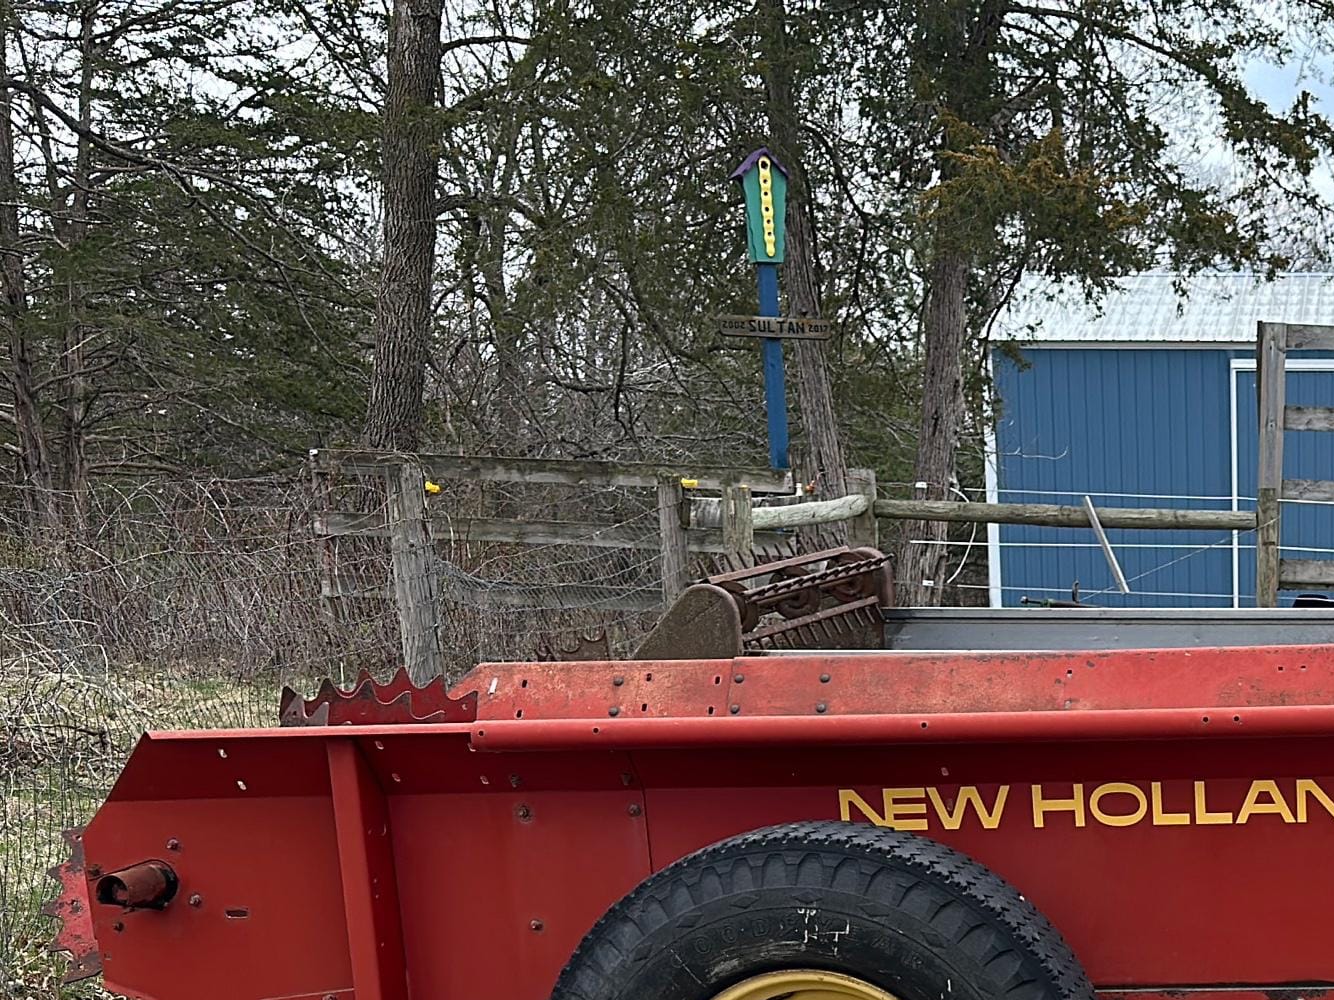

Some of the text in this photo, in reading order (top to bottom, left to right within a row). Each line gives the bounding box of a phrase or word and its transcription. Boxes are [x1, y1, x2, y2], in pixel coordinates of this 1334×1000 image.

[748, 319, 805, 334] SULTAN
[808, 324, 828, 333] 2017
[838, 784, 1010, 831] NEW
